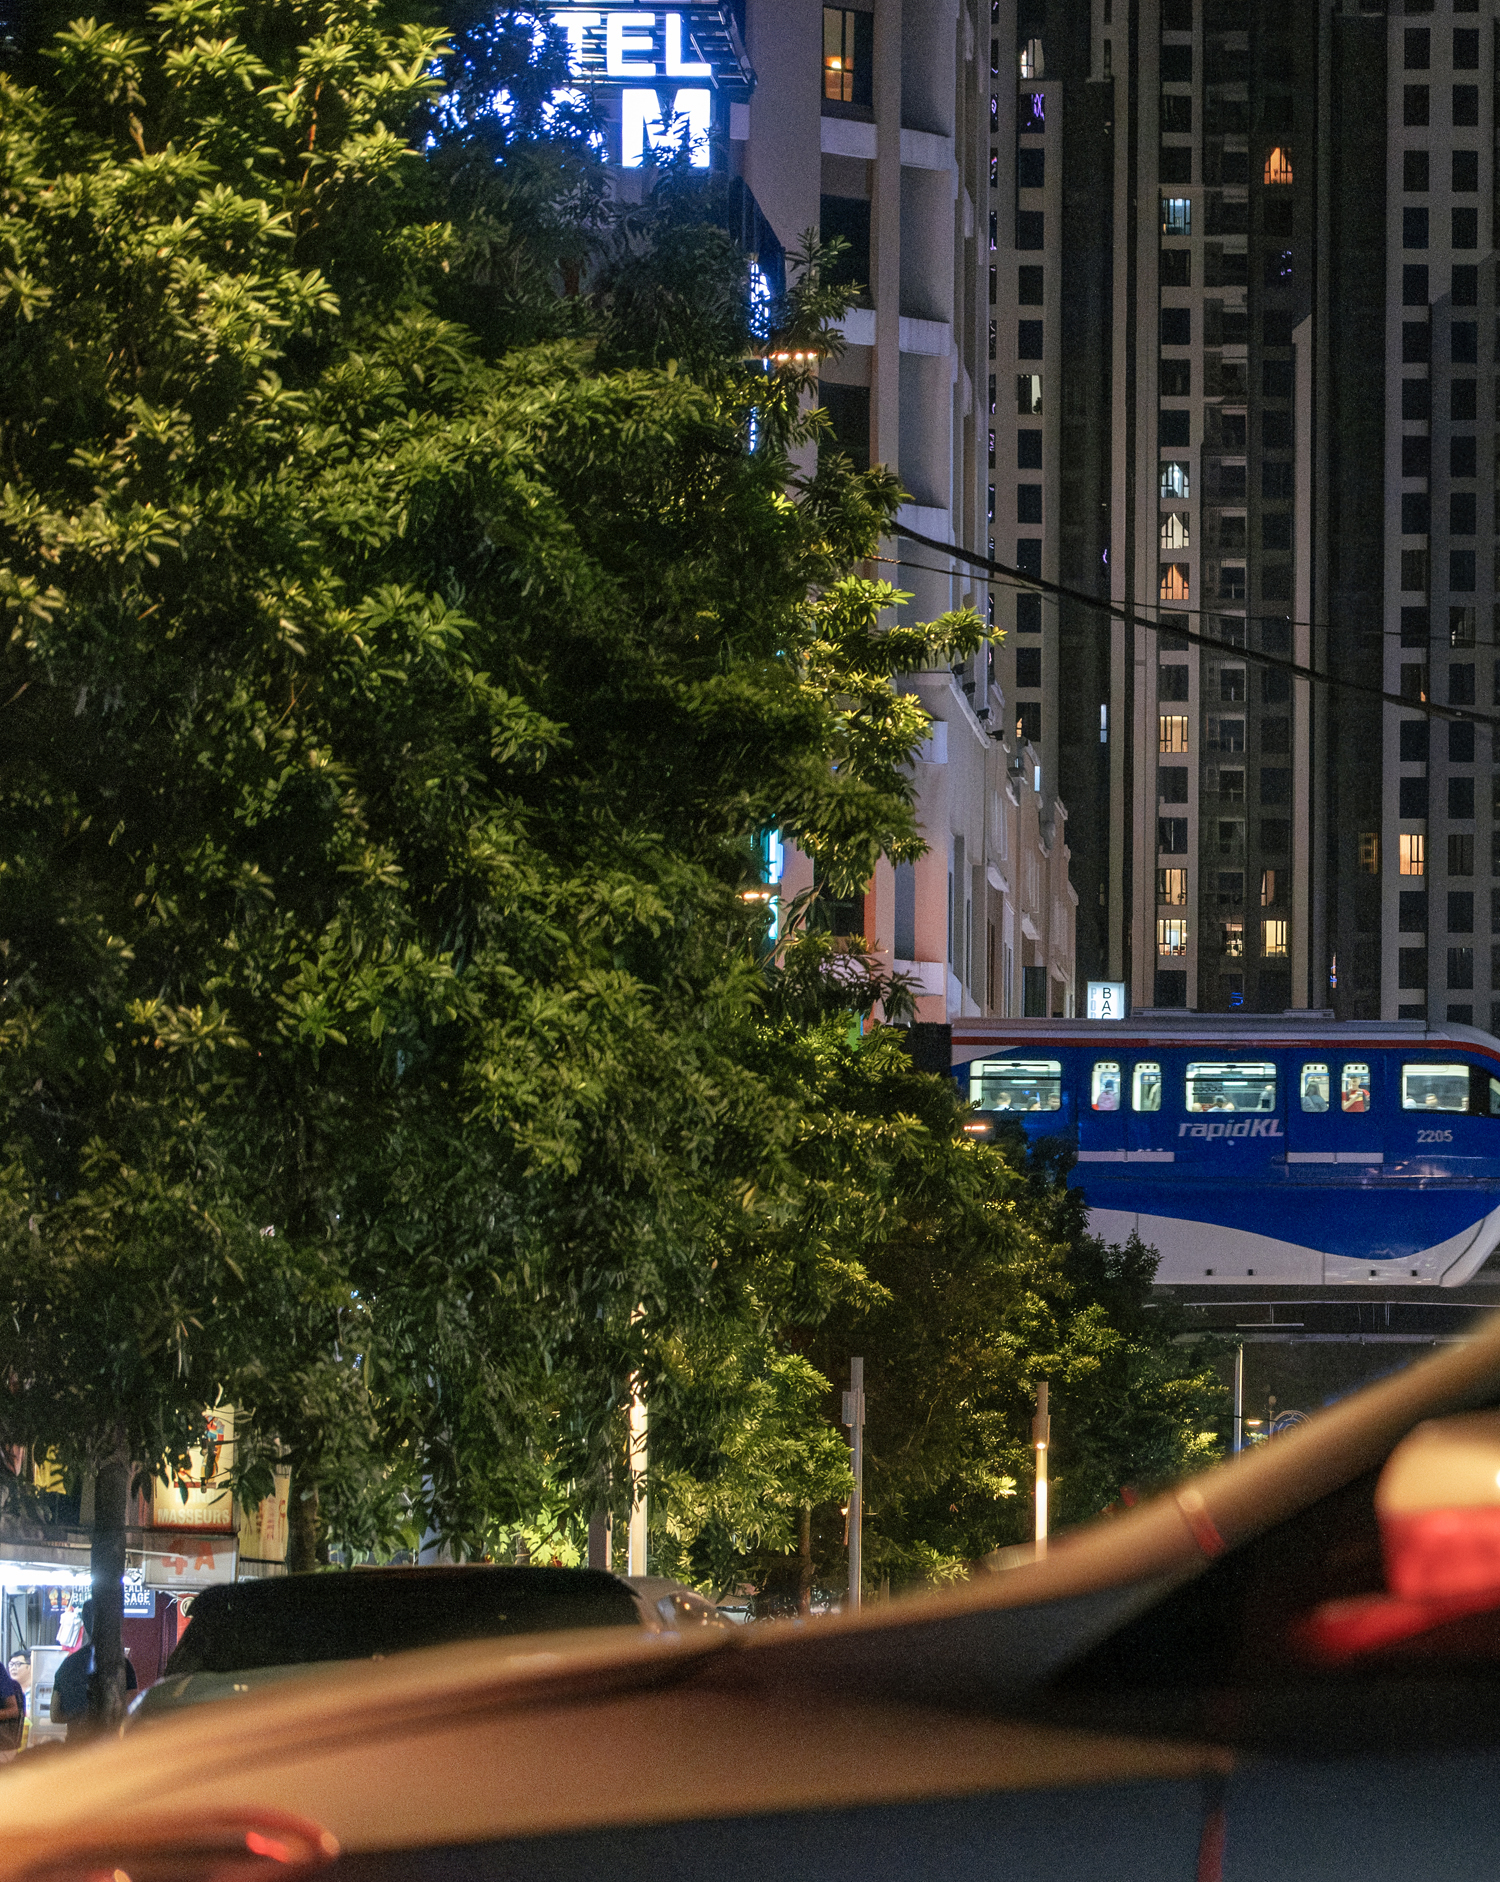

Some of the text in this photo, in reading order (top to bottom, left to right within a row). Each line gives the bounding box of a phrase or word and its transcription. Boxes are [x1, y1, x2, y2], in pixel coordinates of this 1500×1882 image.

[1178, 1118, 1284, 1141] rapidKL
[1417, 1130, 1453, 1143] 2205
[157, 1508, 230, 1525] MASSEURS
